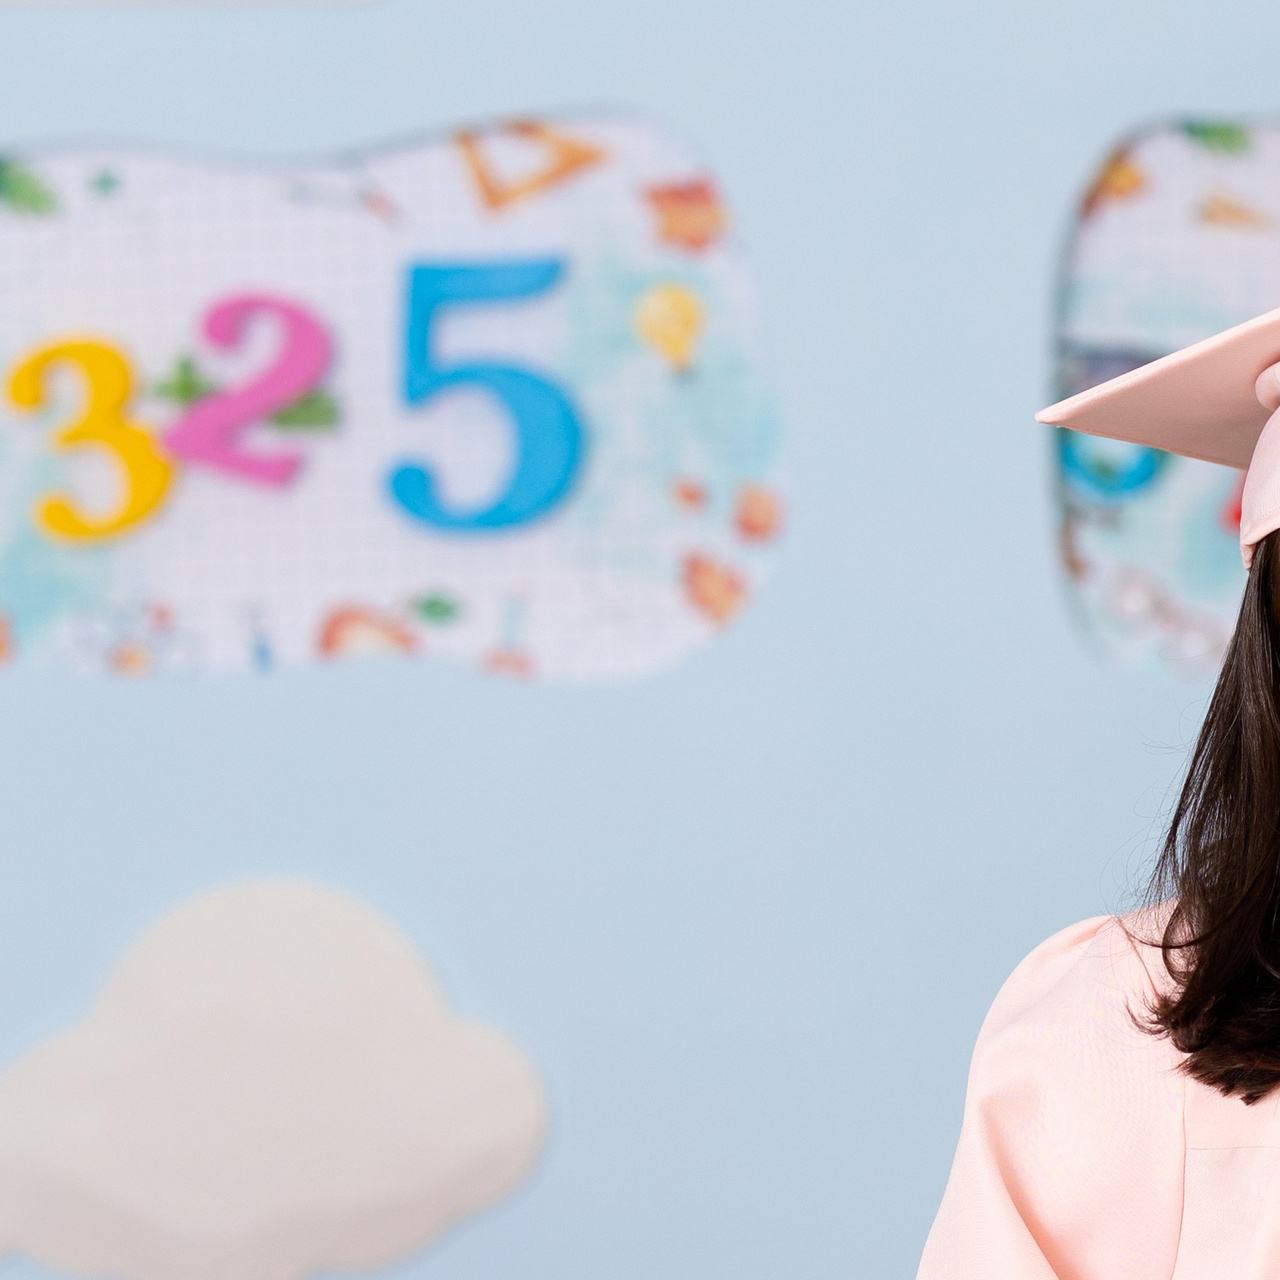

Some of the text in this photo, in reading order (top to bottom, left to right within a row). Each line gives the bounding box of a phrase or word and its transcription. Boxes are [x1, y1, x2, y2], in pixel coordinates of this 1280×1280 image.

[5, 257, 591, 543] 3 2 5
